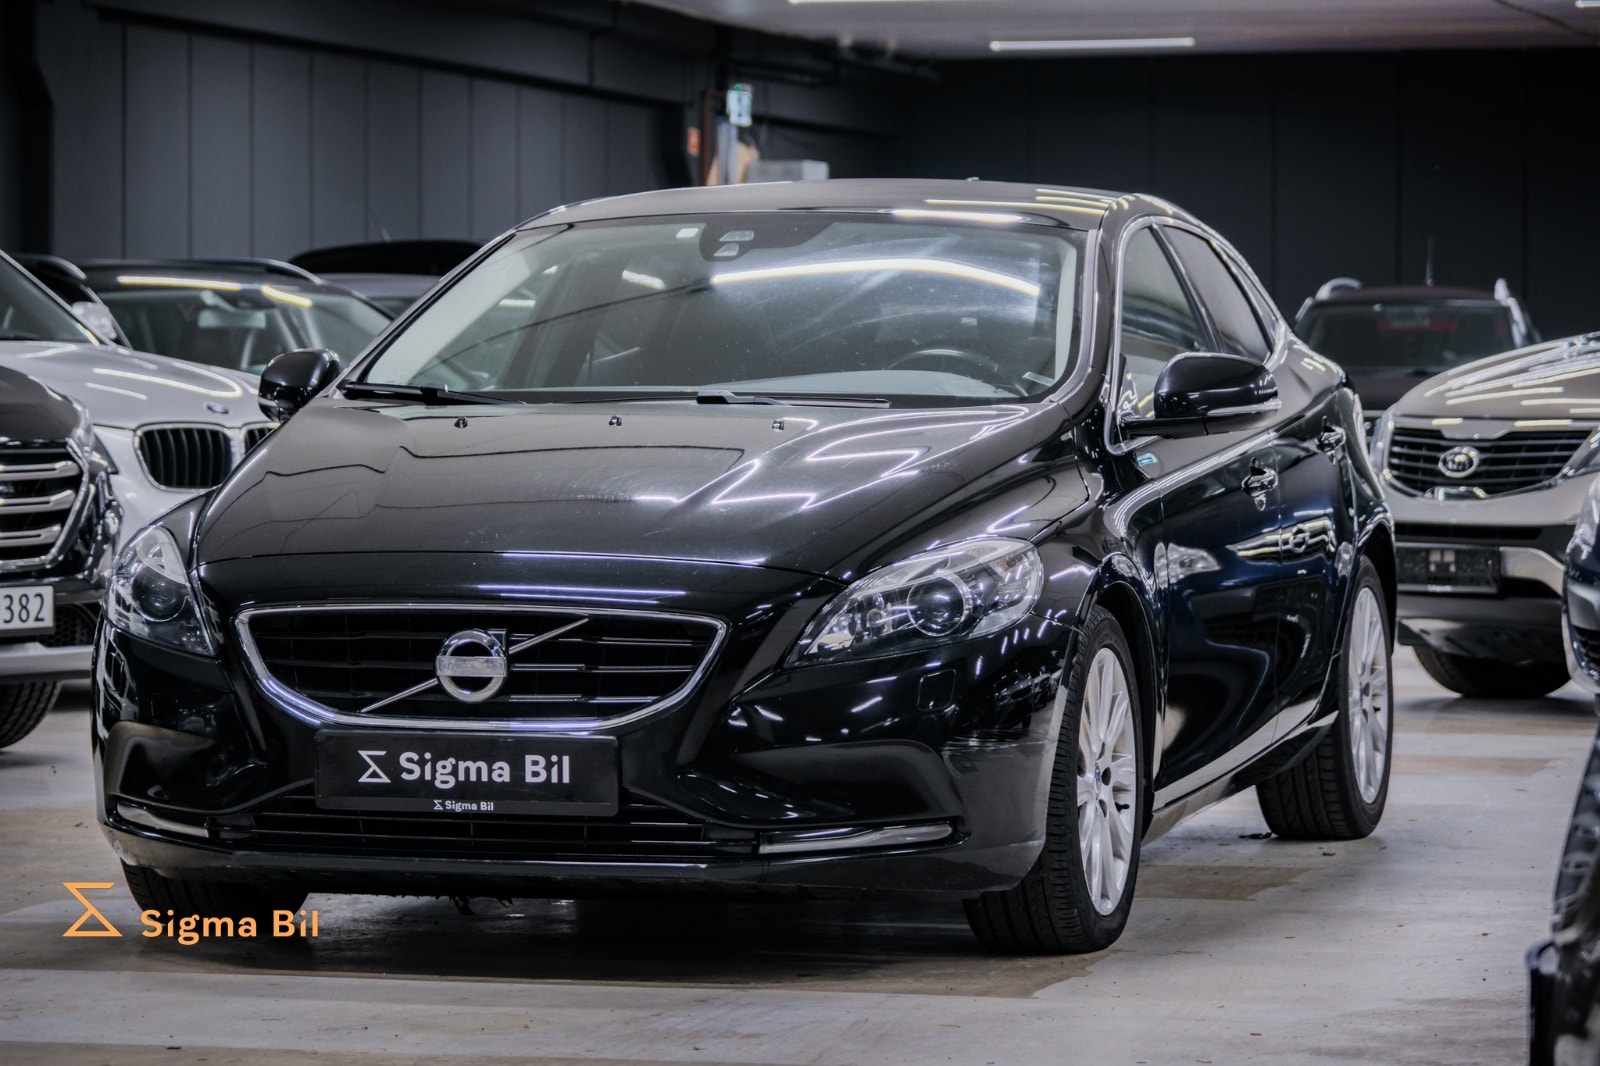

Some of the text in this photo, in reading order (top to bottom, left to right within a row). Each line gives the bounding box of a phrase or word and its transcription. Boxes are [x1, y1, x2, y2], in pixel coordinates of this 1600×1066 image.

[3, 592, 45, 624] 382
[399, 751, 570, 790] Sigma Bil
[444, 800, 495, 813] Sigma Bil
